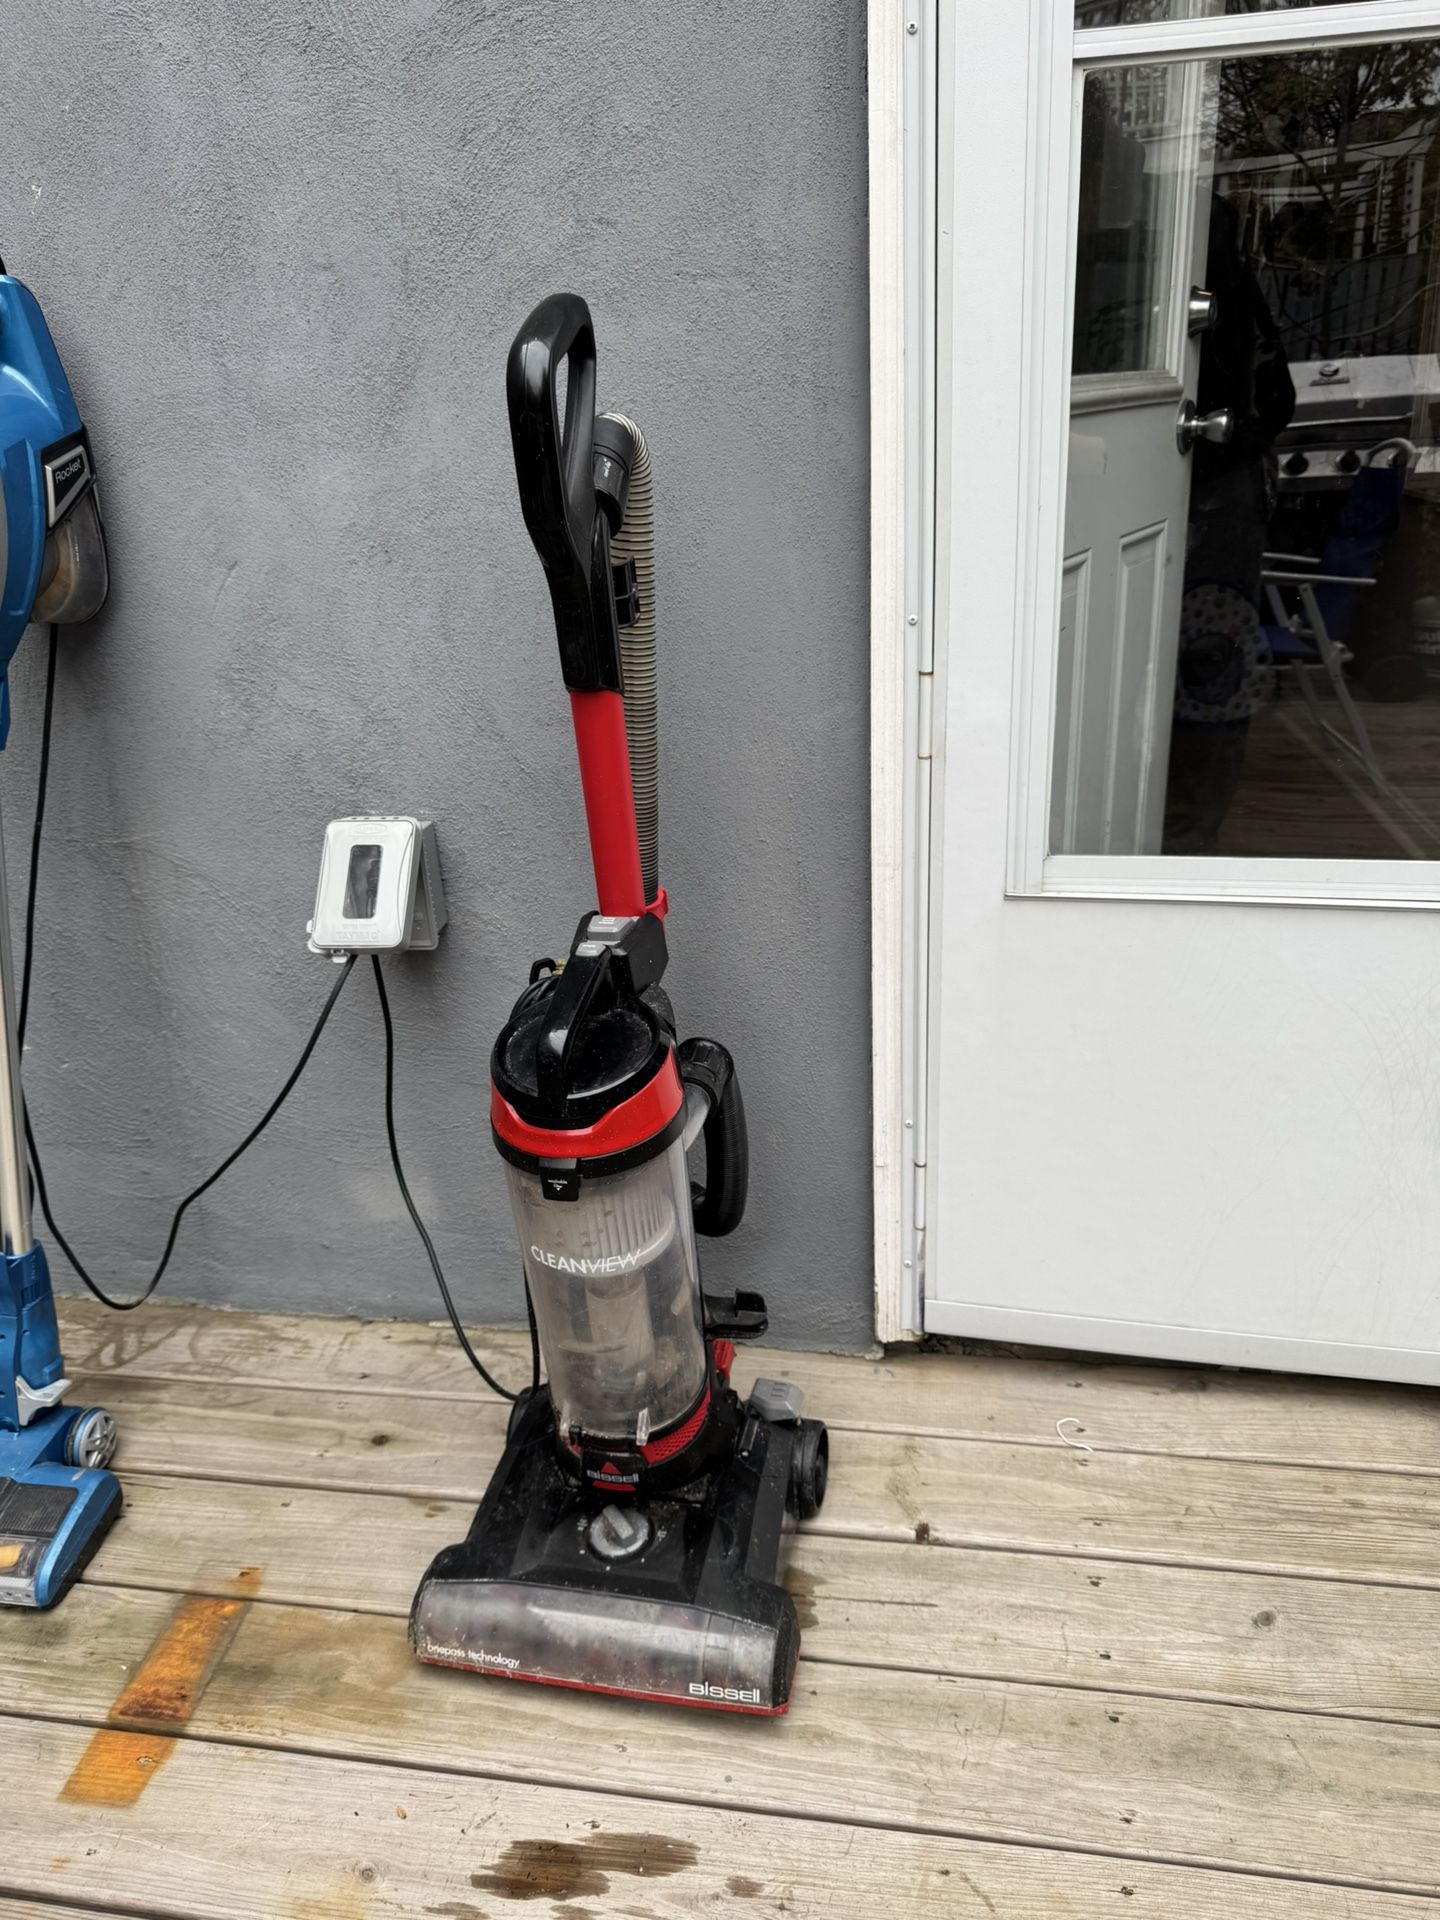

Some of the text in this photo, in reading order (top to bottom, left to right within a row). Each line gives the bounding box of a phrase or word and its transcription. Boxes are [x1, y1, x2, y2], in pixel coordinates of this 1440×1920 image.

[55, 458, 82, 484] Rocket
[530, 1245, 641, 1274] CLEANVIEW
[427, 1643, 520, 1668] onepass technology
